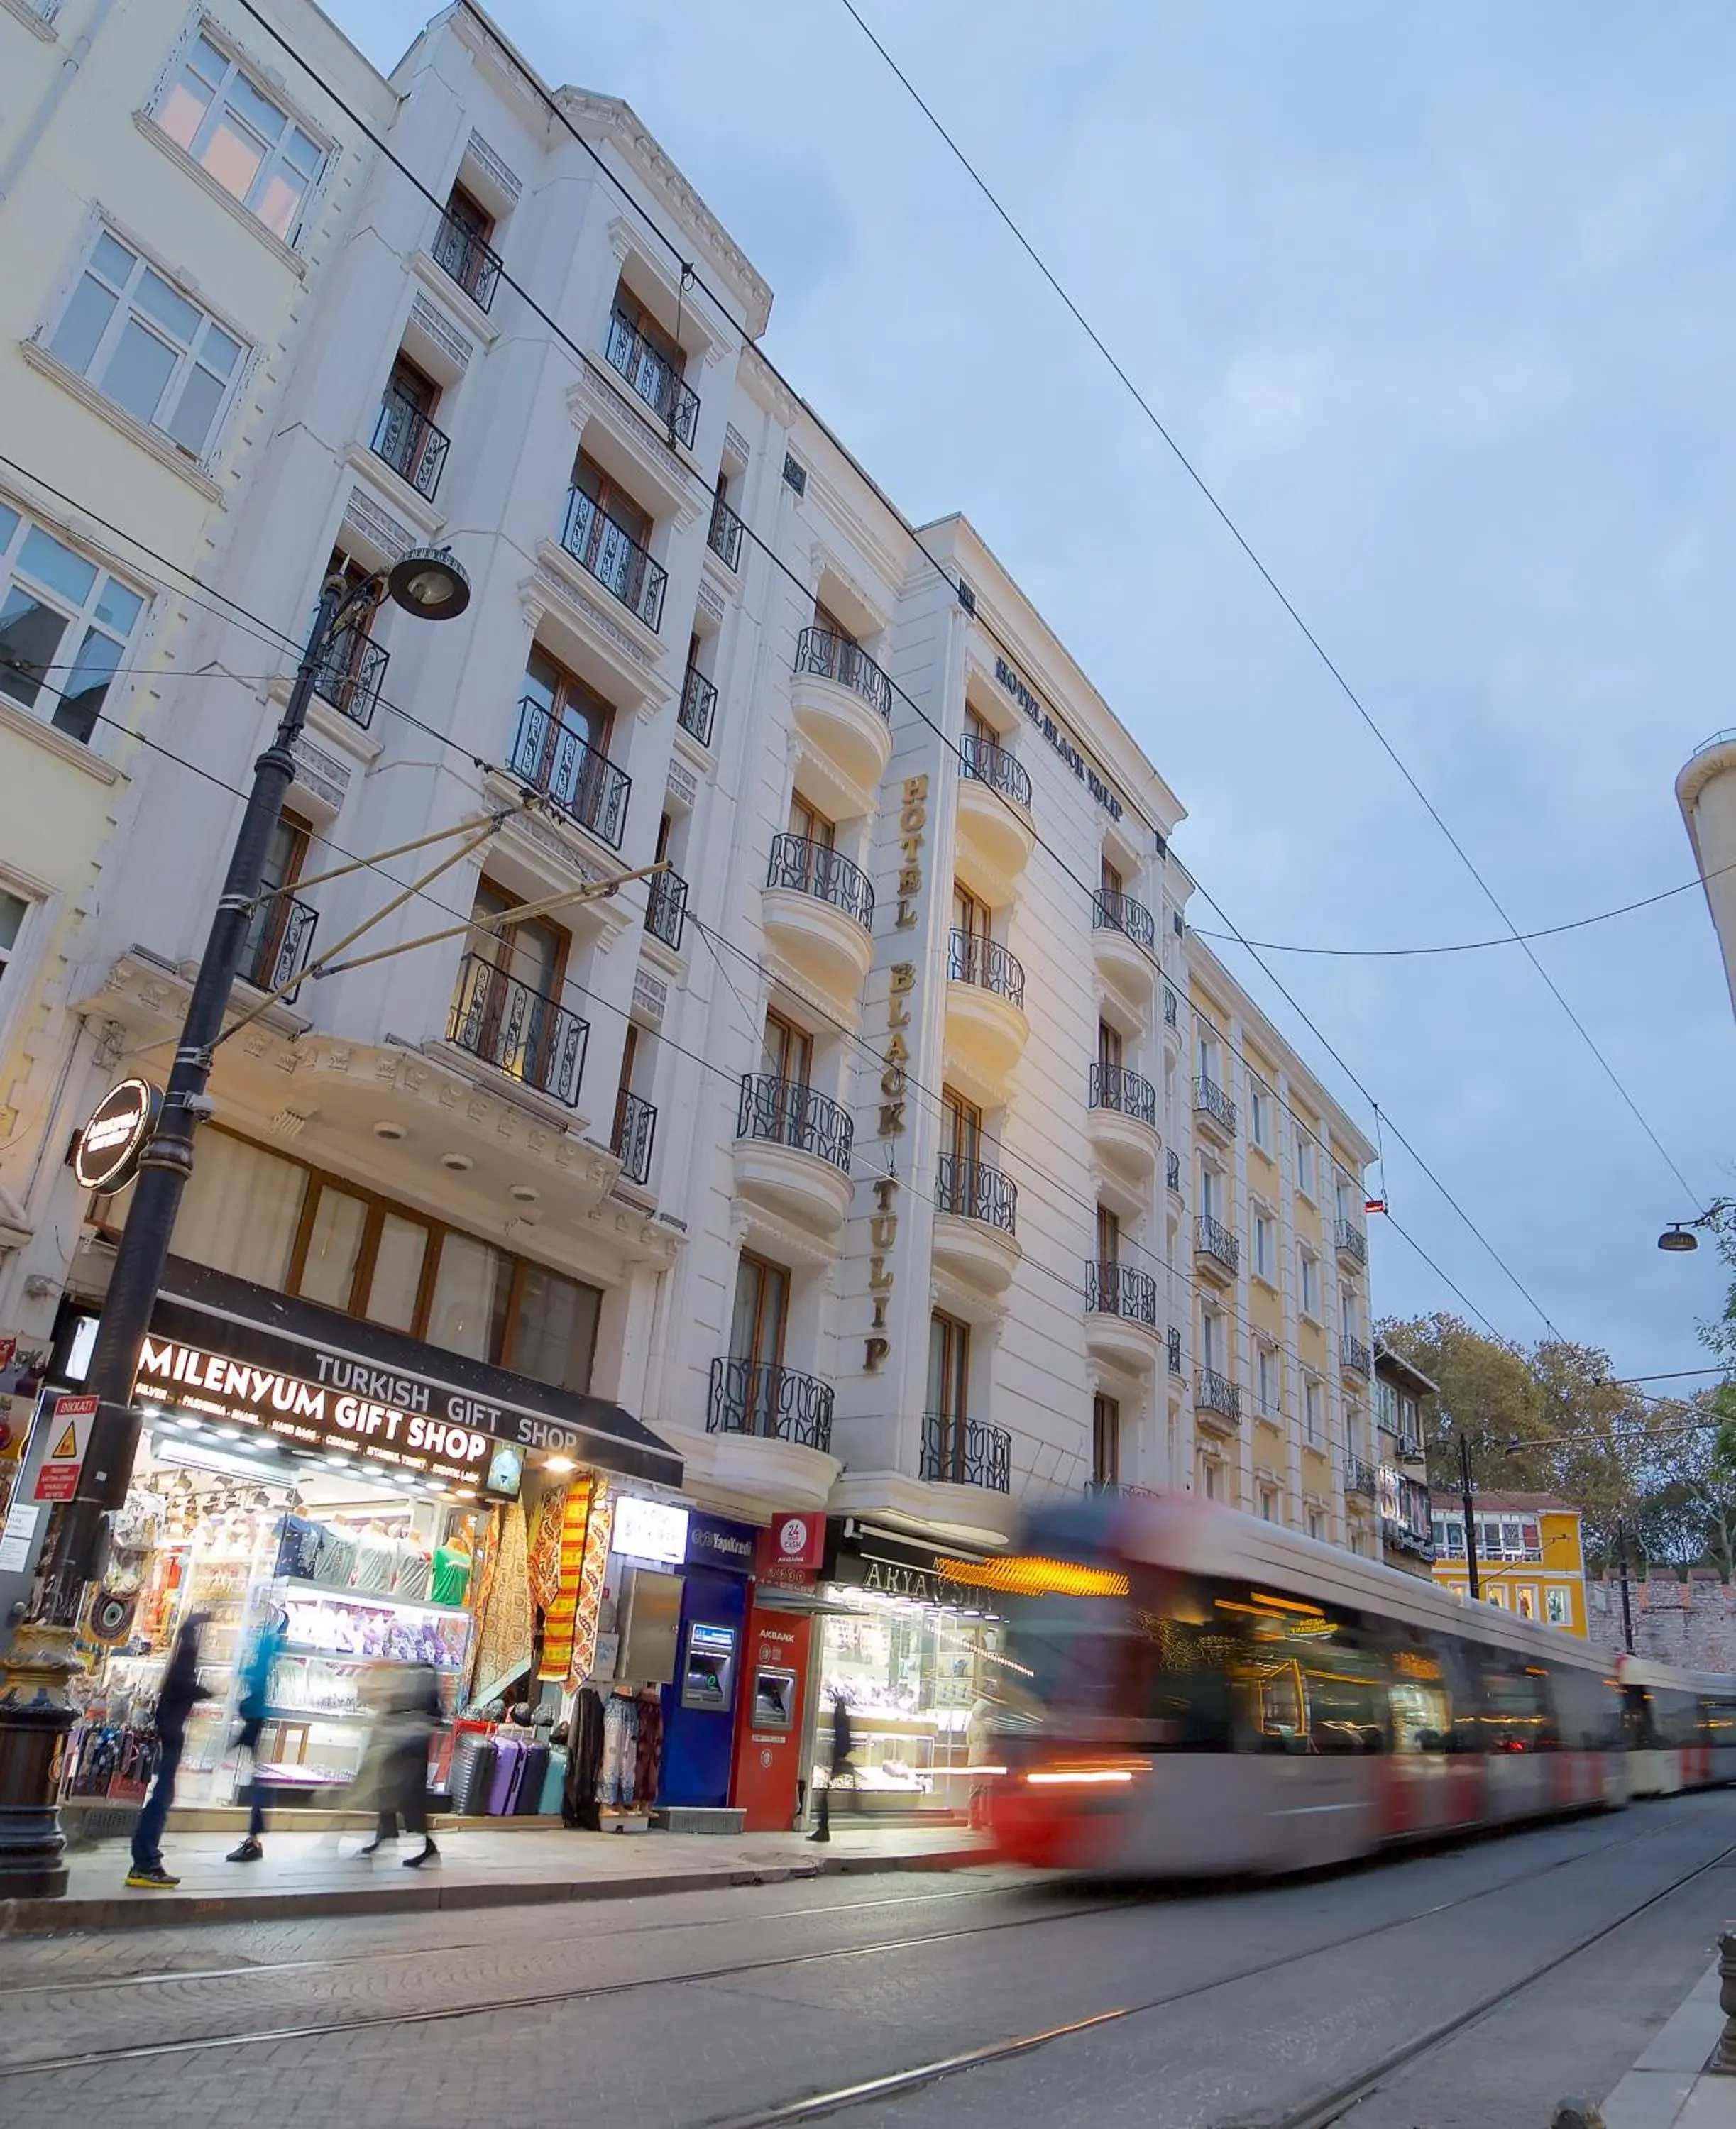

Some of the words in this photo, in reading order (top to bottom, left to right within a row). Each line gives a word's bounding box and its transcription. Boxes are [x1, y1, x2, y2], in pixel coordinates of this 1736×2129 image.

[996, 656, 1043, 729] HOTEL
[1043, 715, 1086, 781] BLACK
[1087, 768, 1124, 823] TULIP
[895, 774, 929, 929] HOTEL
[877, 962, 916, 1138] BLACK
[863, 1179, 899, 1371] TULIP
[138, 1337, 325, 1420] MILENYUM
[334, 1396, 404, 1440] GIFT
[407, 1417, 487, 1462] SHOP
[316, 1353, 430, 1412] TURKISH
[447, 1396, 501, 1432] GIFT
[517, 1419, 578, 1451] SHOP
[788, 1524, 799, 1536] 24
[759, 1629, 795, 1644] AKBANK
